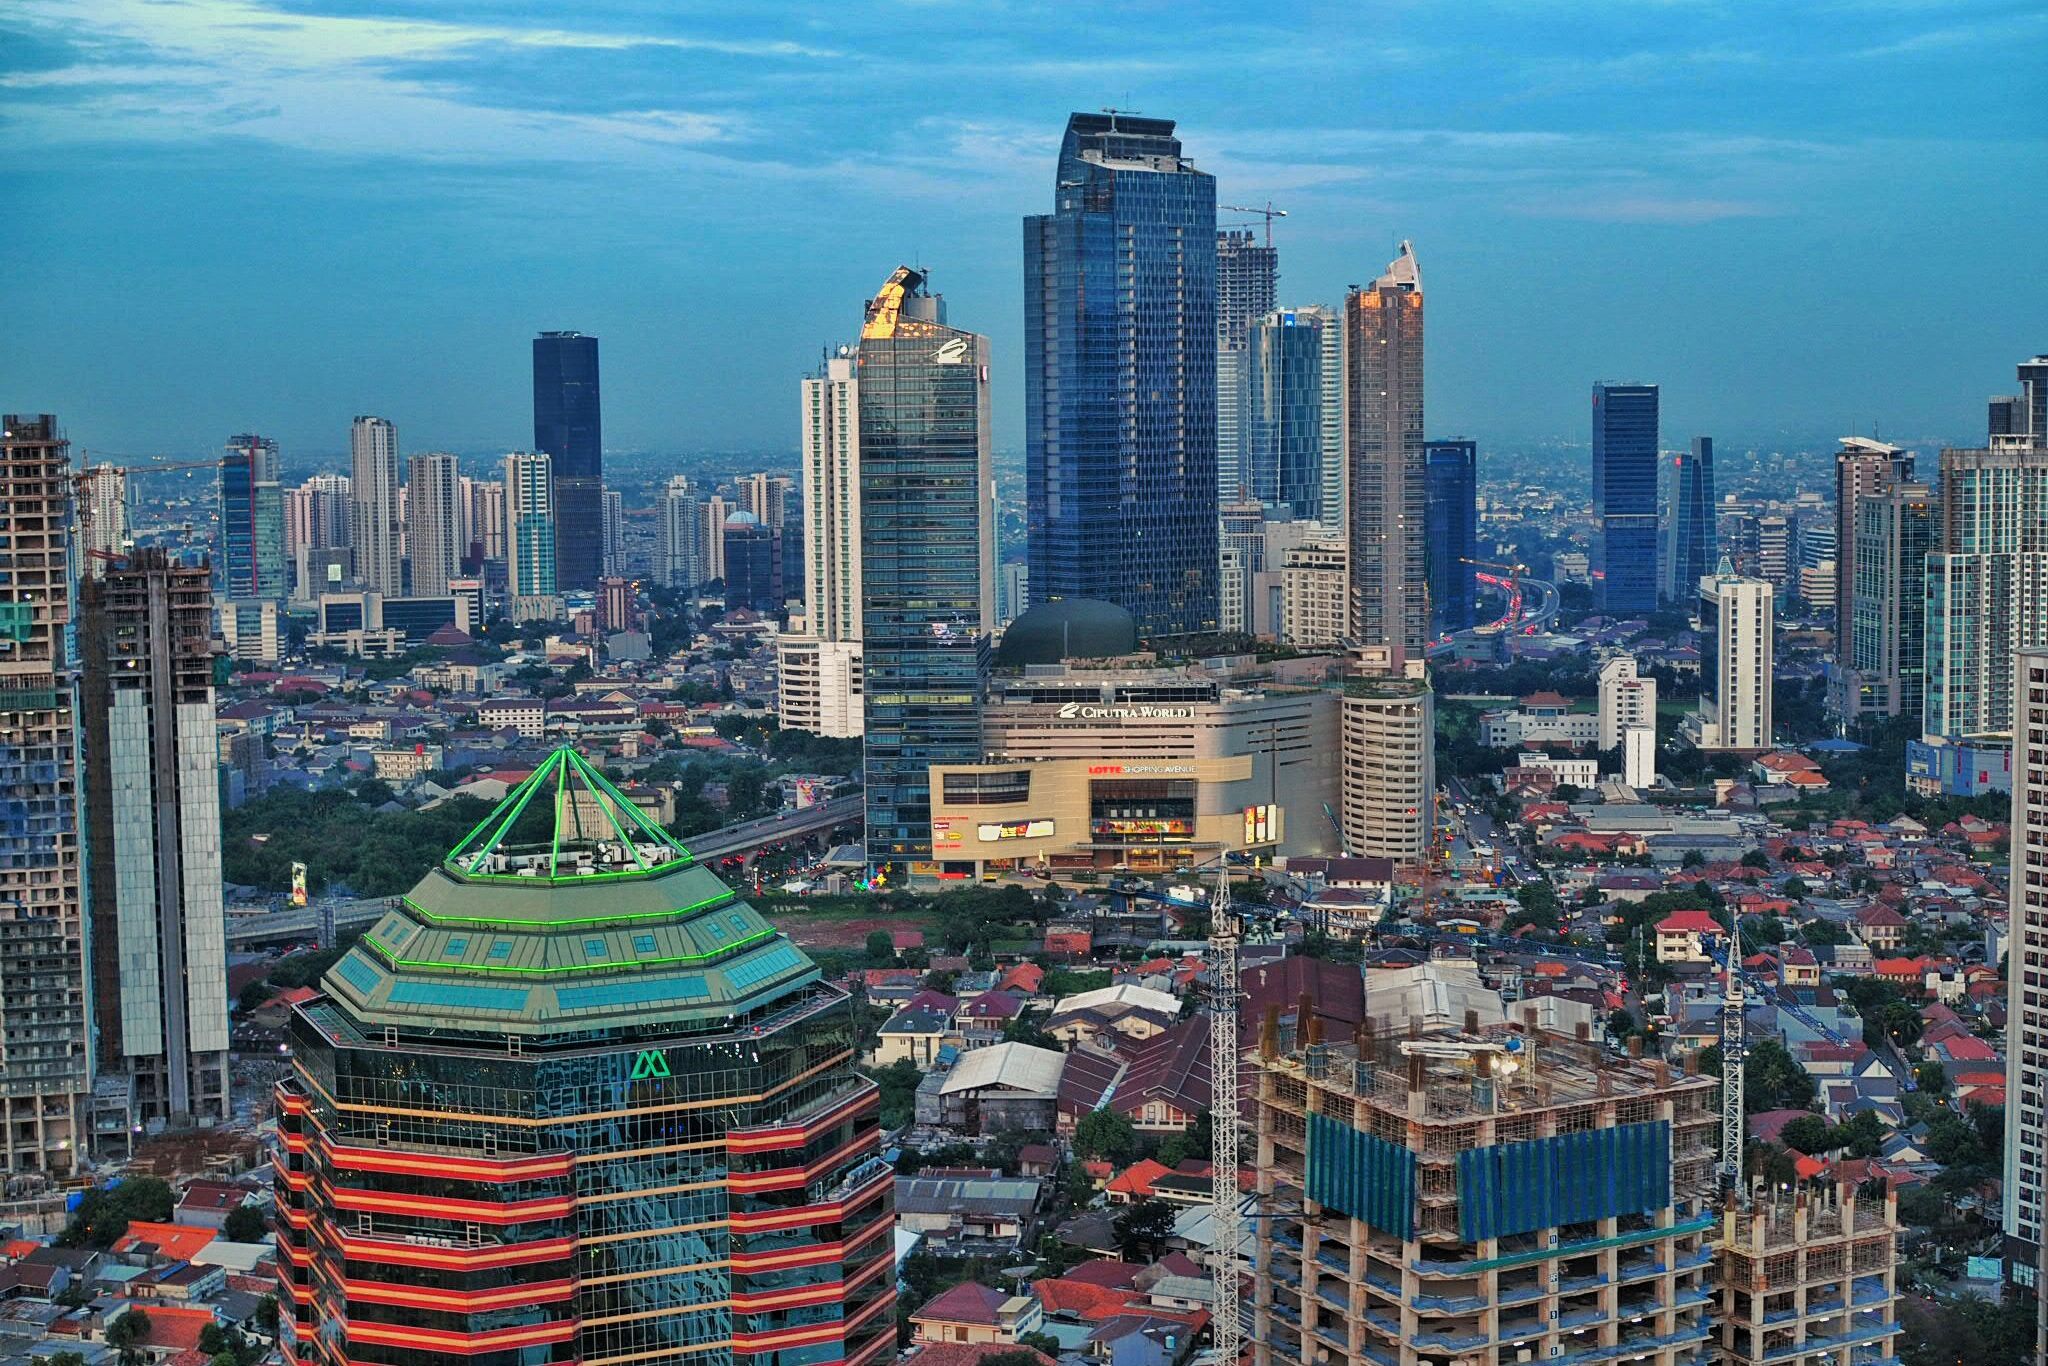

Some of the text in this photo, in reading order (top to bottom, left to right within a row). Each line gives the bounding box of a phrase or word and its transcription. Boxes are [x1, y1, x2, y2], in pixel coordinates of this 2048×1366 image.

[1081, 706, 1137, 718] CIPUTRA
[1139, 706, 1186, 718] WORLD
[1088, 766, 1121, 774] LOTTE
